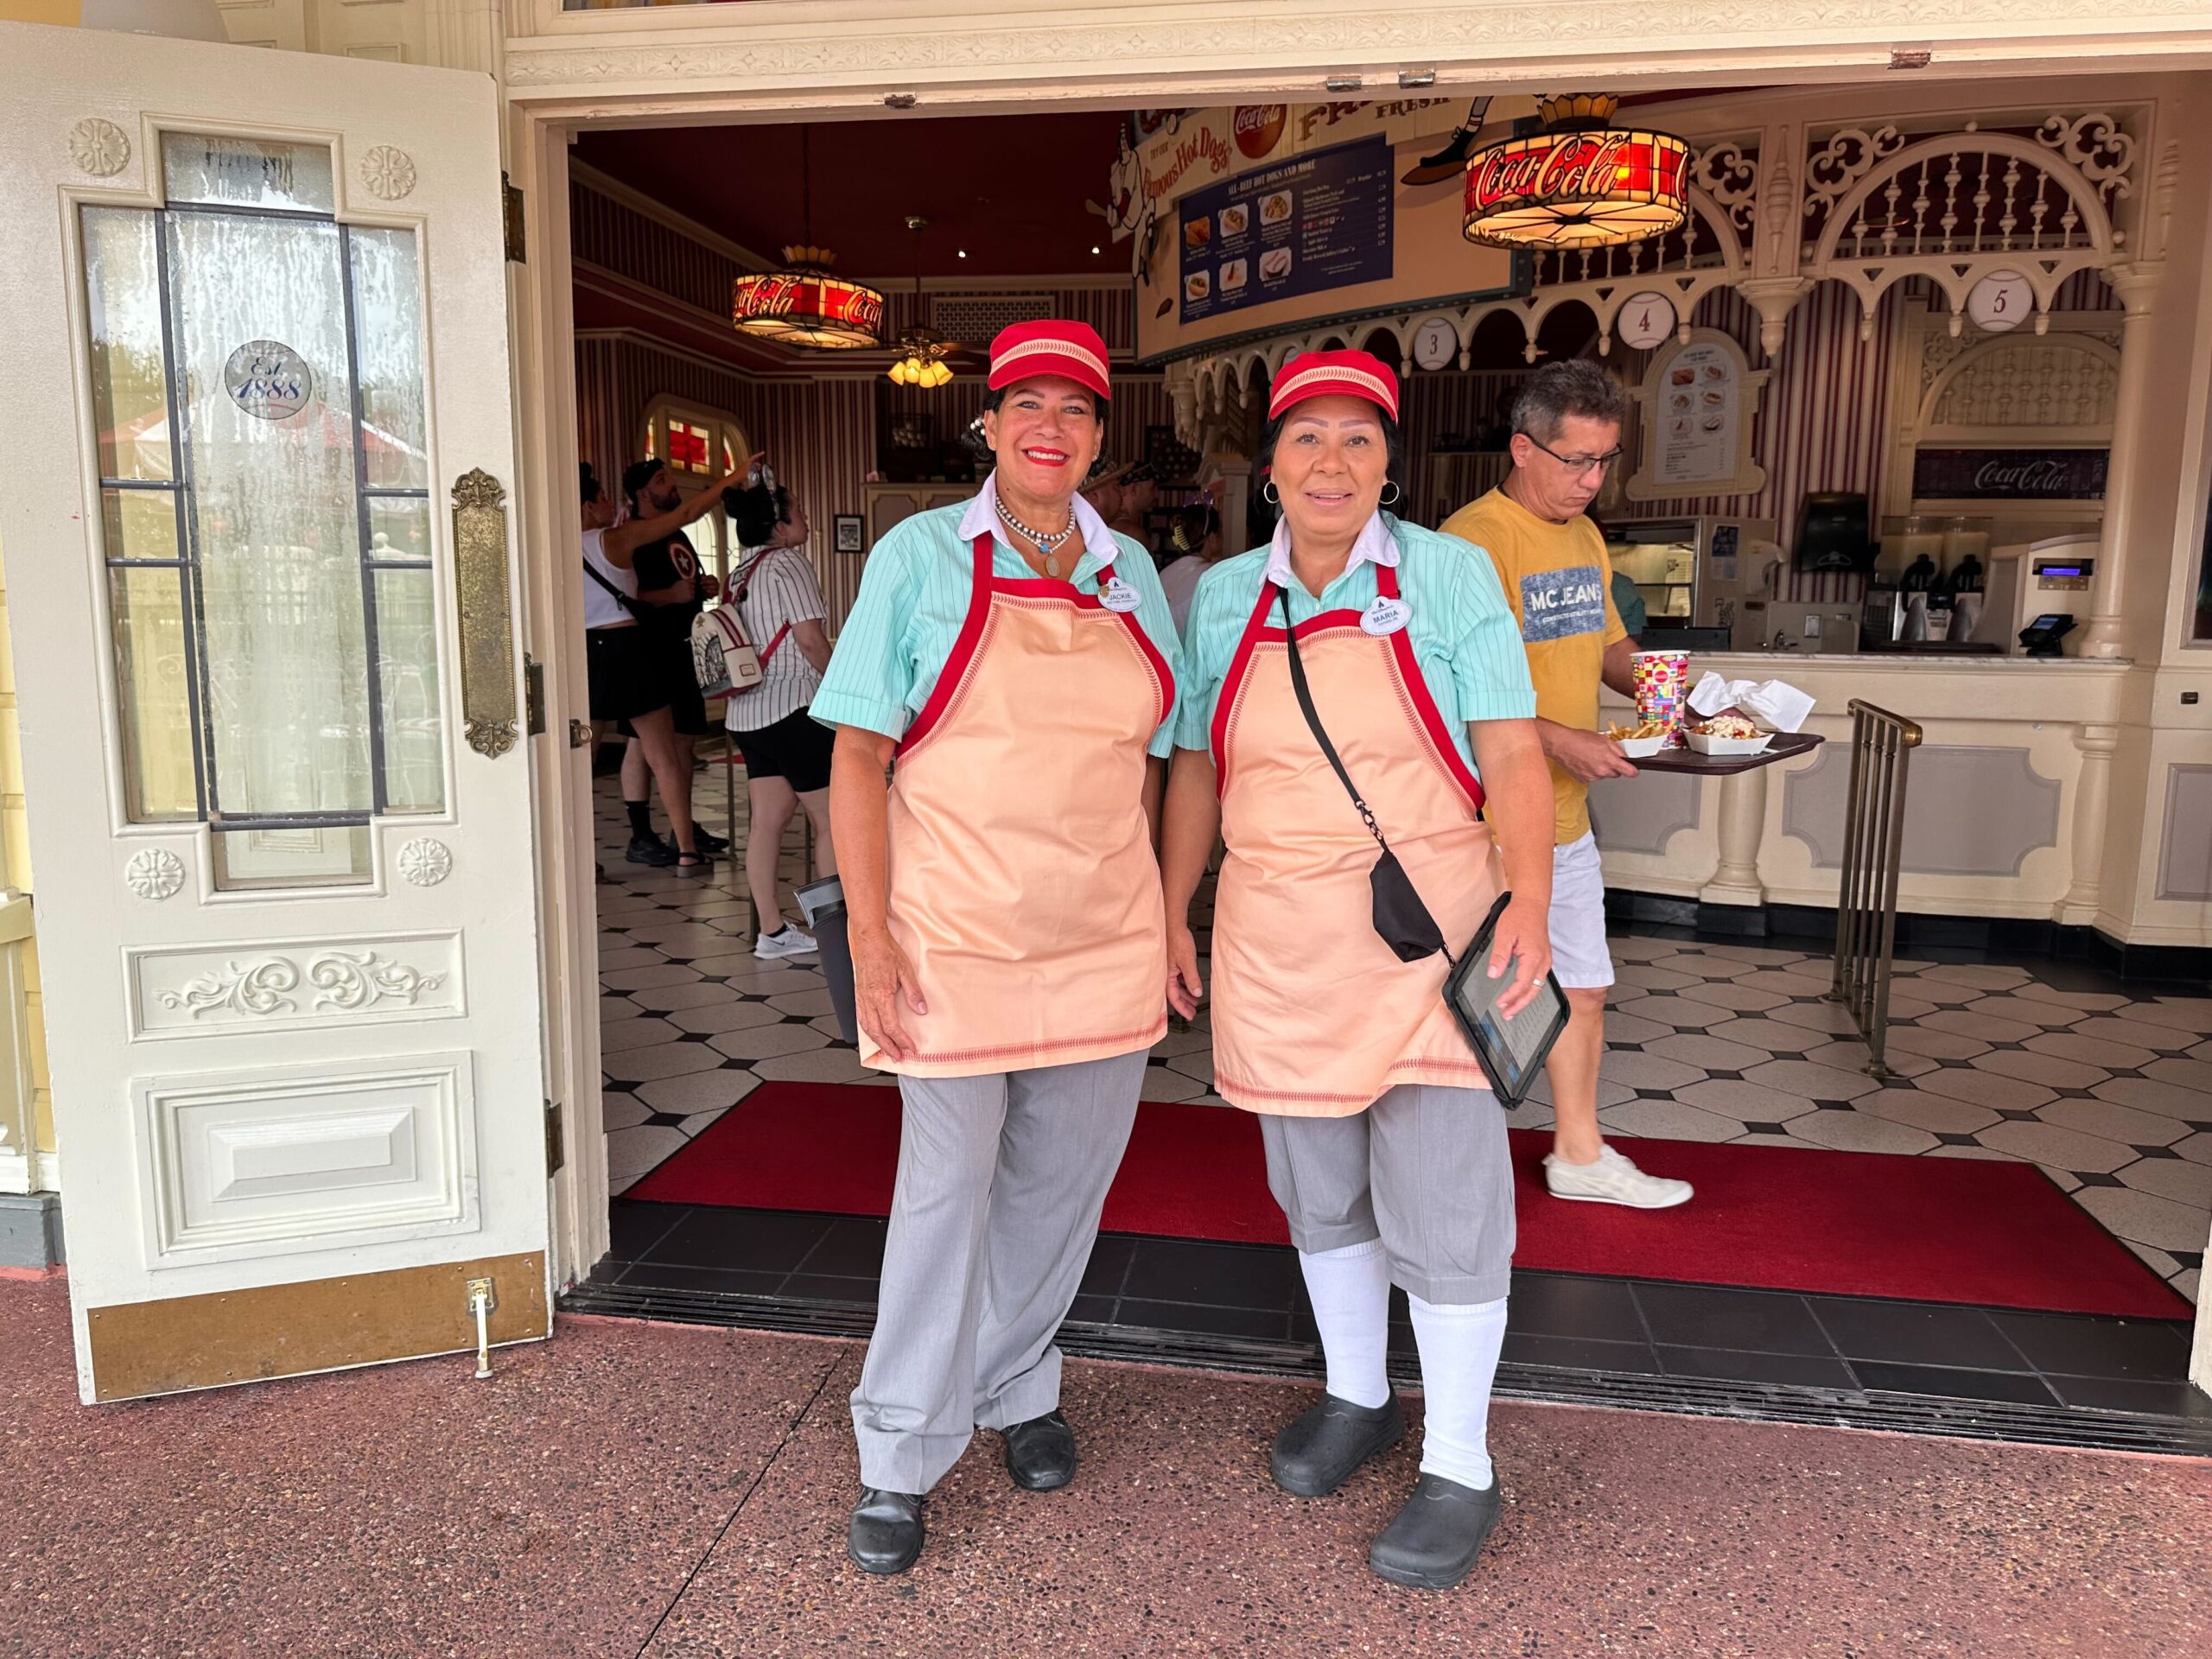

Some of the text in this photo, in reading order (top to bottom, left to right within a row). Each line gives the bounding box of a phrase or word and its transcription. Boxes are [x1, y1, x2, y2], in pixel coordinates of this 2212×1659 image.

[1142, 164, 1179, 199] Famous
[1175, 132, 1198, 175] Hot
[1476, 135, 1623, 210] Coca-Cola
[1993, 289, 2008, 315] 5
[1638, 308, 1650, 332] 4
[1430, 334, 1438, 355] 3
[251, 356, 283, 375] Est.
[234, 378, 302, 400] 1888
[1530, 588, 1558, 612] MC
[1373, 610, 1399, 624] MARIA
